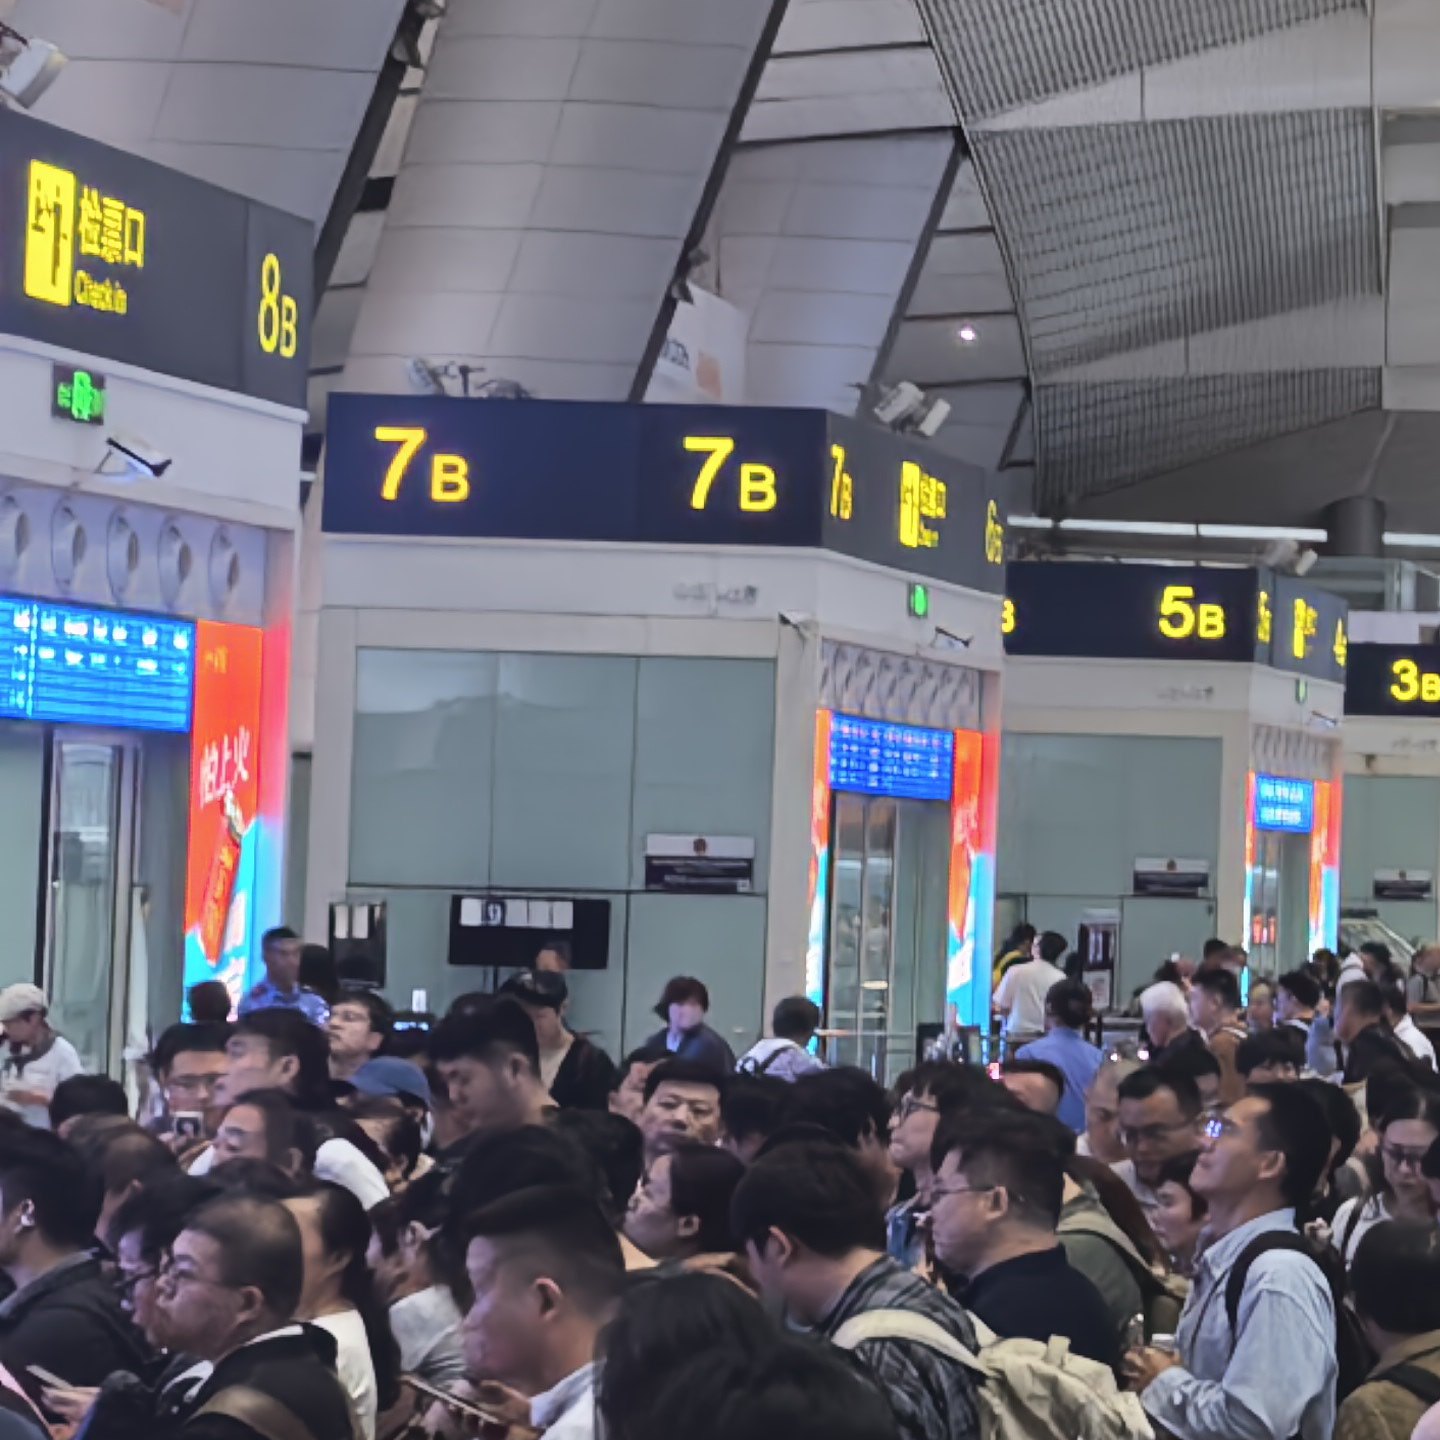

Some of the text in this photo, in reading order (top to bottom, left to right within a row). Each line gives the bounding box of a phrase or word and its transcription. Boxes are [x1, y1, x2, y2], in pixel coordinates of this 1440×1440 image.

[78, 185, 146, 269] 检票口
[258, 252, 298, 358] 8B
[374, 426, 471, 502] 7B
[683, 436, 777, 512] 7B
[830, 444, 853, 520] 7B
[1158, 585, 1227, 640] 5B
[200, 725, 250, 811] 怕上火
